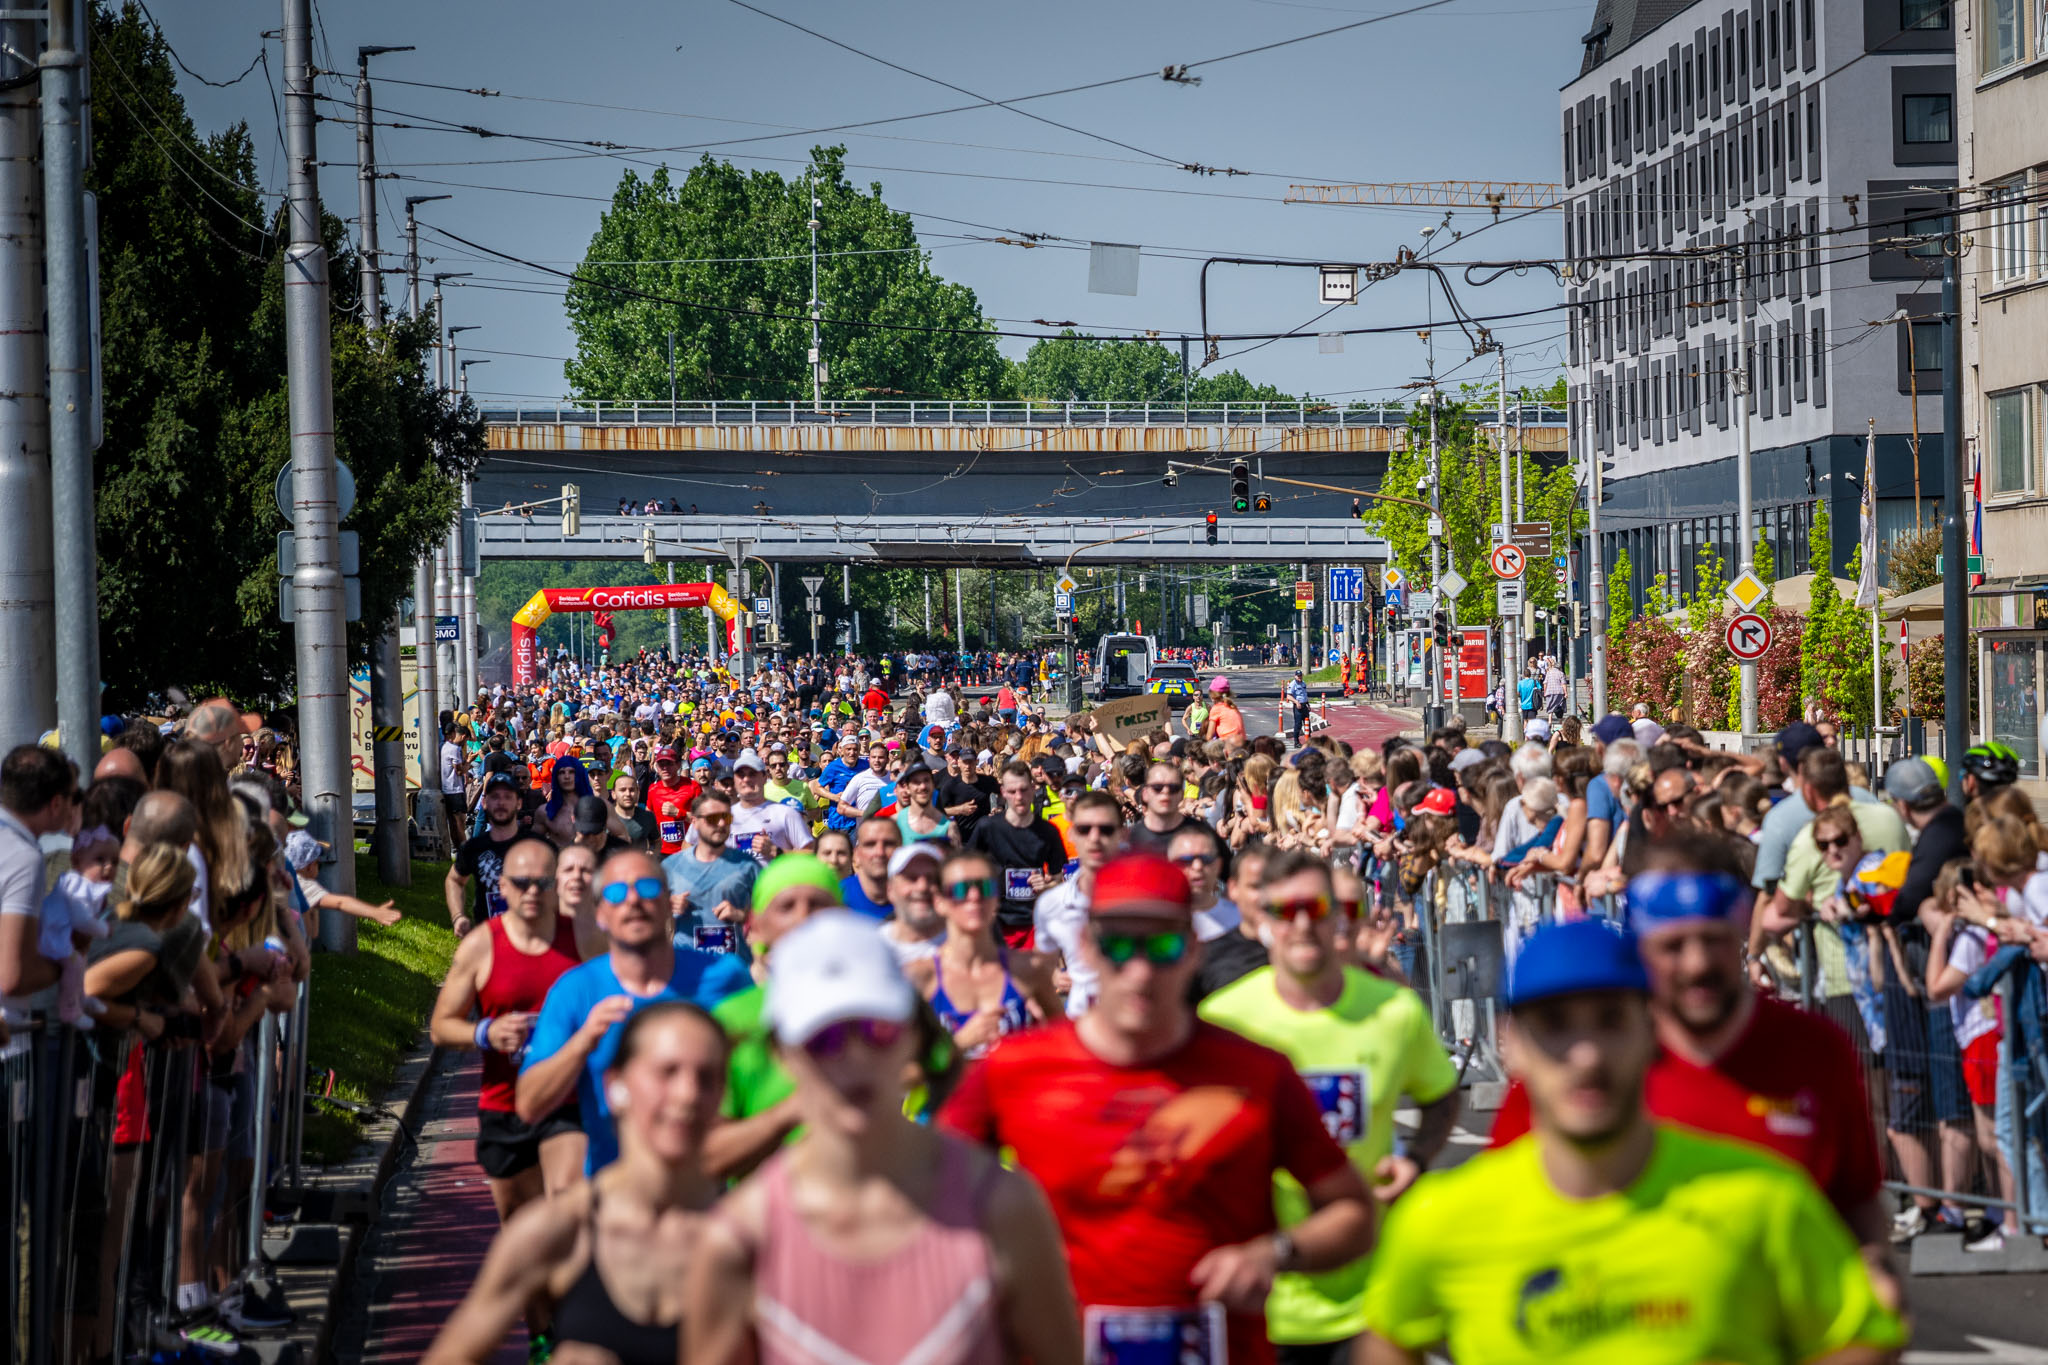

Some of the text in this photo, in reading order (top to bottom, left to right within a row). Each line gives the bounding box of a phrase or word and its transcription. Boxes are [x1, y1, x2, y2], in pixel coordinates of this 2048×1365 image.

[592, 590, 664, 608] Cofidis
[516, 637, 532, 686] ofidis
[1115, 710, 1159, 729] FOREST
[1009, 886, 1031, 897] 1880
